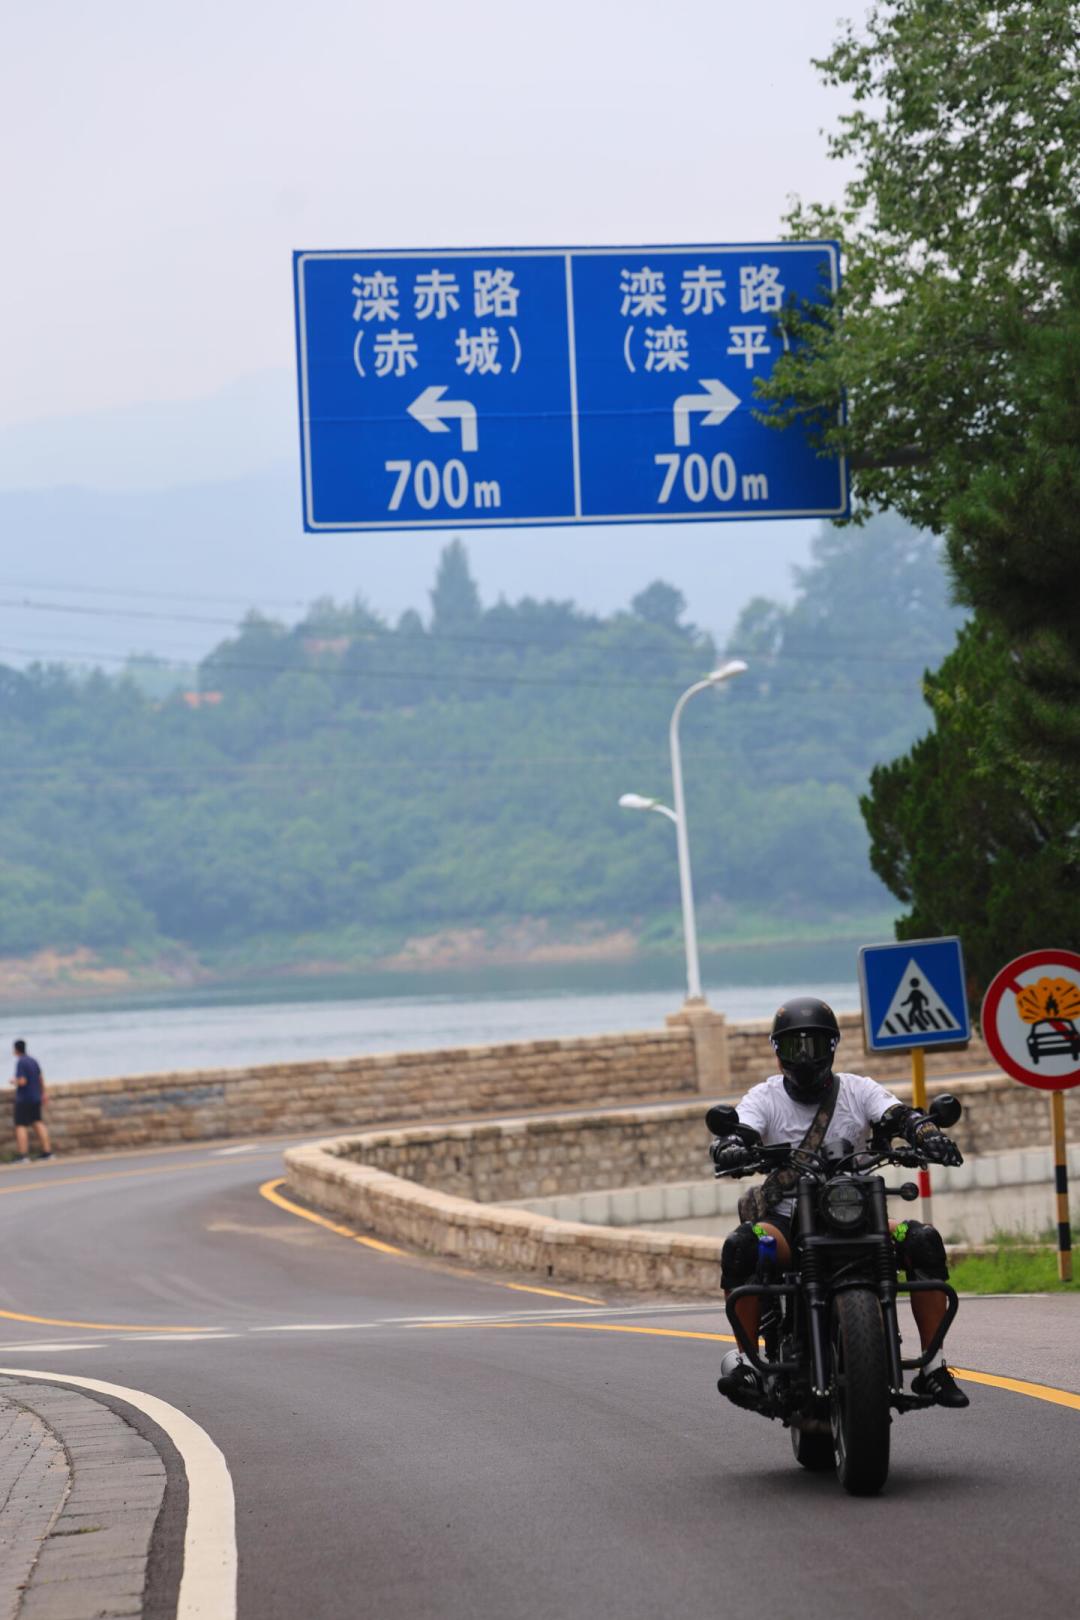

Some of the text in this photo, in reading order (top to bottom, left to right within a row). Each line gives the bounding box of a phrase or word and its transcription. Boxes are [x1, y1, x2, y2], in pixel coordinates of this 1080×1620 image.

[352, 268, 521, 321] 滦赤路
[620, 264, 786, 316] 滦赤路
[385, 459, 501, 510] 700m
[655, 452, 768, 503] 700m
